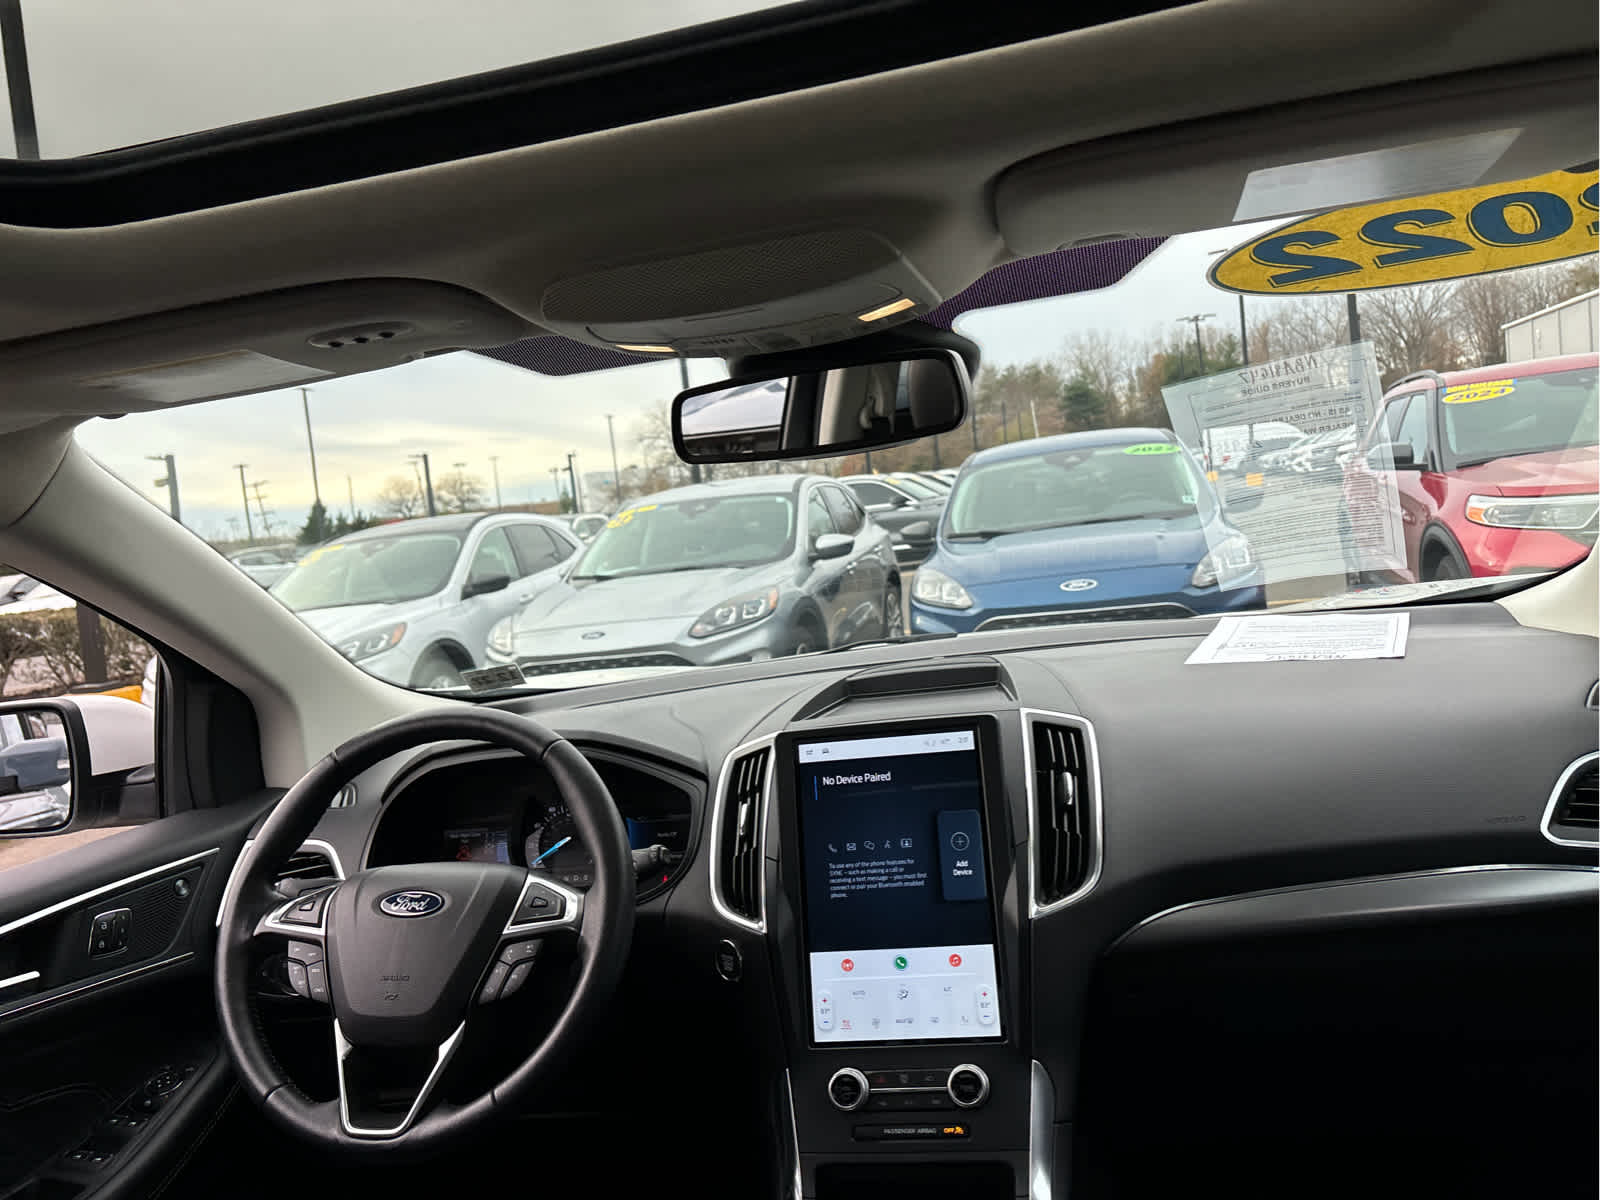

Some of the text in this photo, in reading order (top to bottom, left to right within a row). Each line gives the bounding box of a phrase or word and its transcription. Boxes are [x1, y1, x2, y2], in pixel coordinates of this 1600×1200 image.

[822, 771, 891, 786] No Device Paired
[389, 893, 431, 912] Ford
